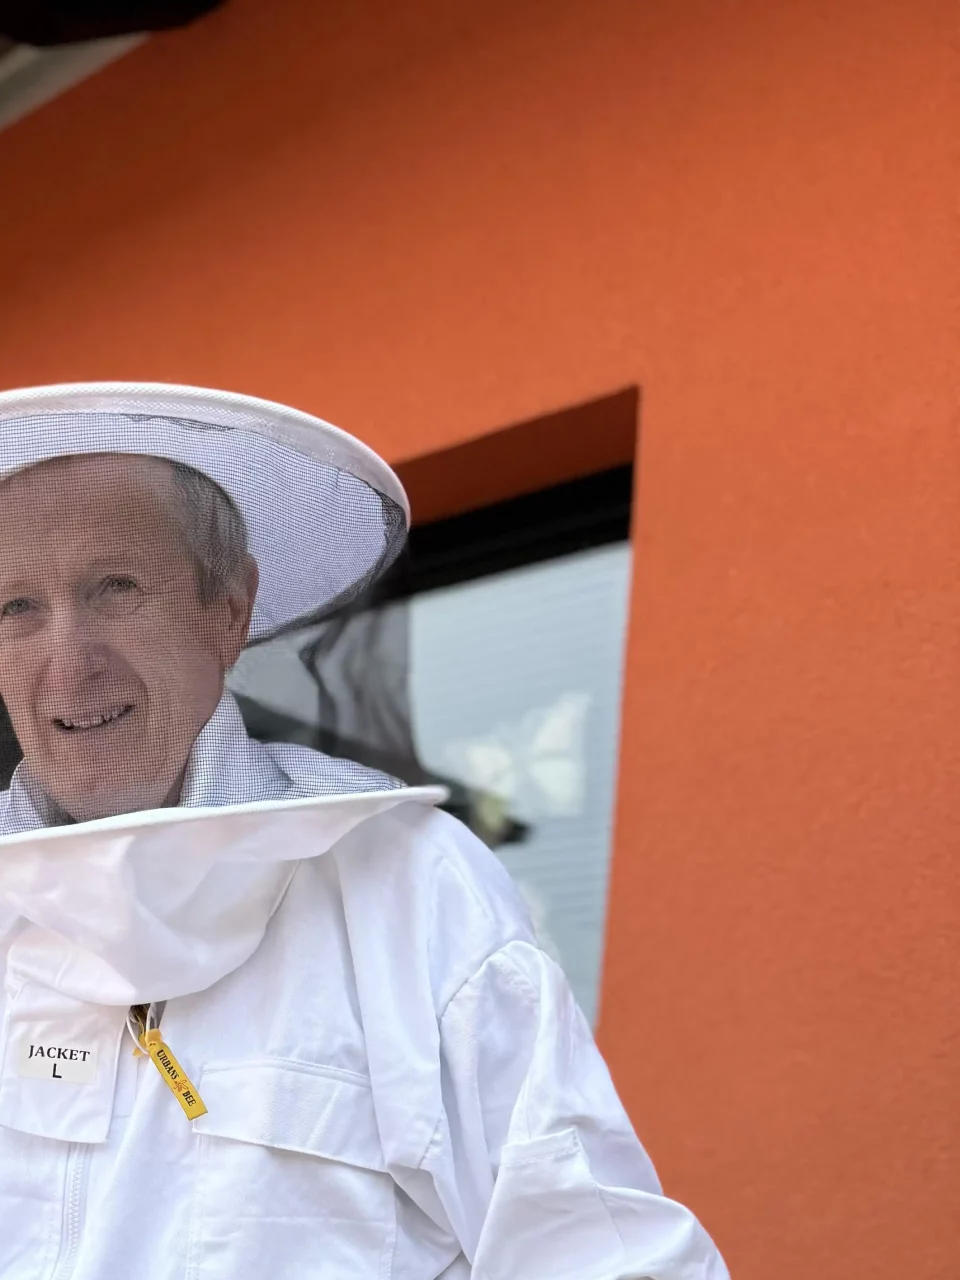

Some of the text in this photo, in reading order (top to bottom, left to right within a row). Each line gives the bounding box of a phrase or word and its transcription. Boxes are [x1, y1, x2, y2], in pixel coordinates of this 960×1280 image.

[28, 1045, 91, 1062] JACKET
[52, 1063, 63, 1079] L
[156, 1049, 197, 1107] URBANS BEE
